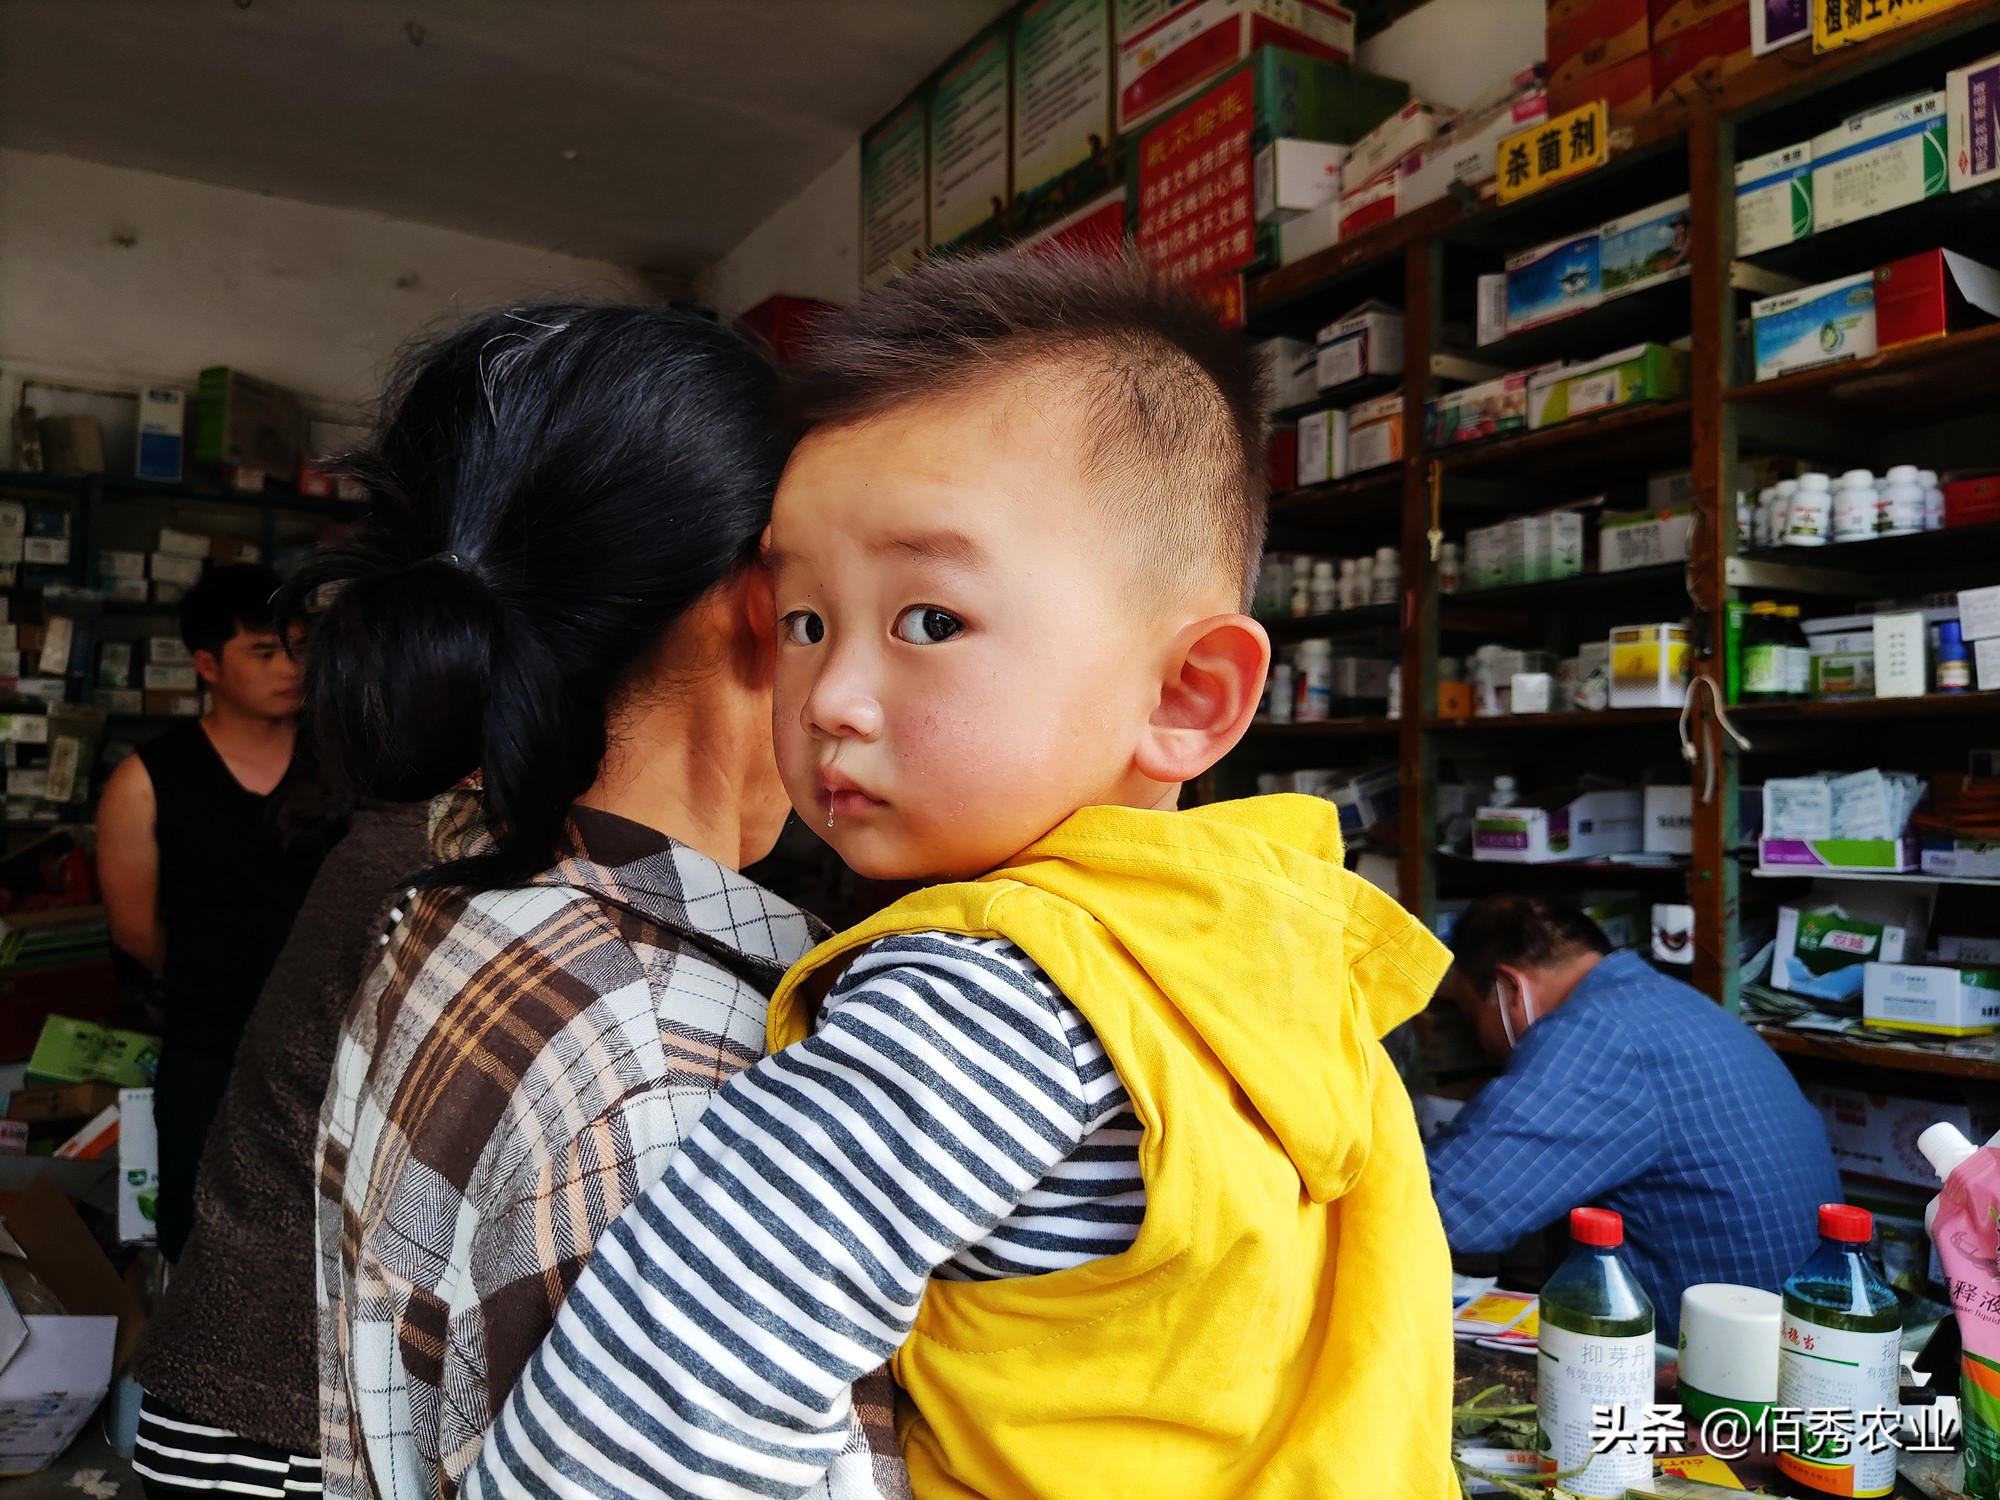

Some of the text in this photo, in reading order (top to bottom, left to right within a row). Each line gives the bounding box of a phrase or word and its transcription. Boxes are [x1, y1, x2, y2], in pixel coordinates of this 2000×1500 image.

[1505, 112, 1595, 187] 杀菌剂
[1945, 1277, 2000, 1314] 释液
[1581, 1342, 1648, 1368] 抑芽丹
